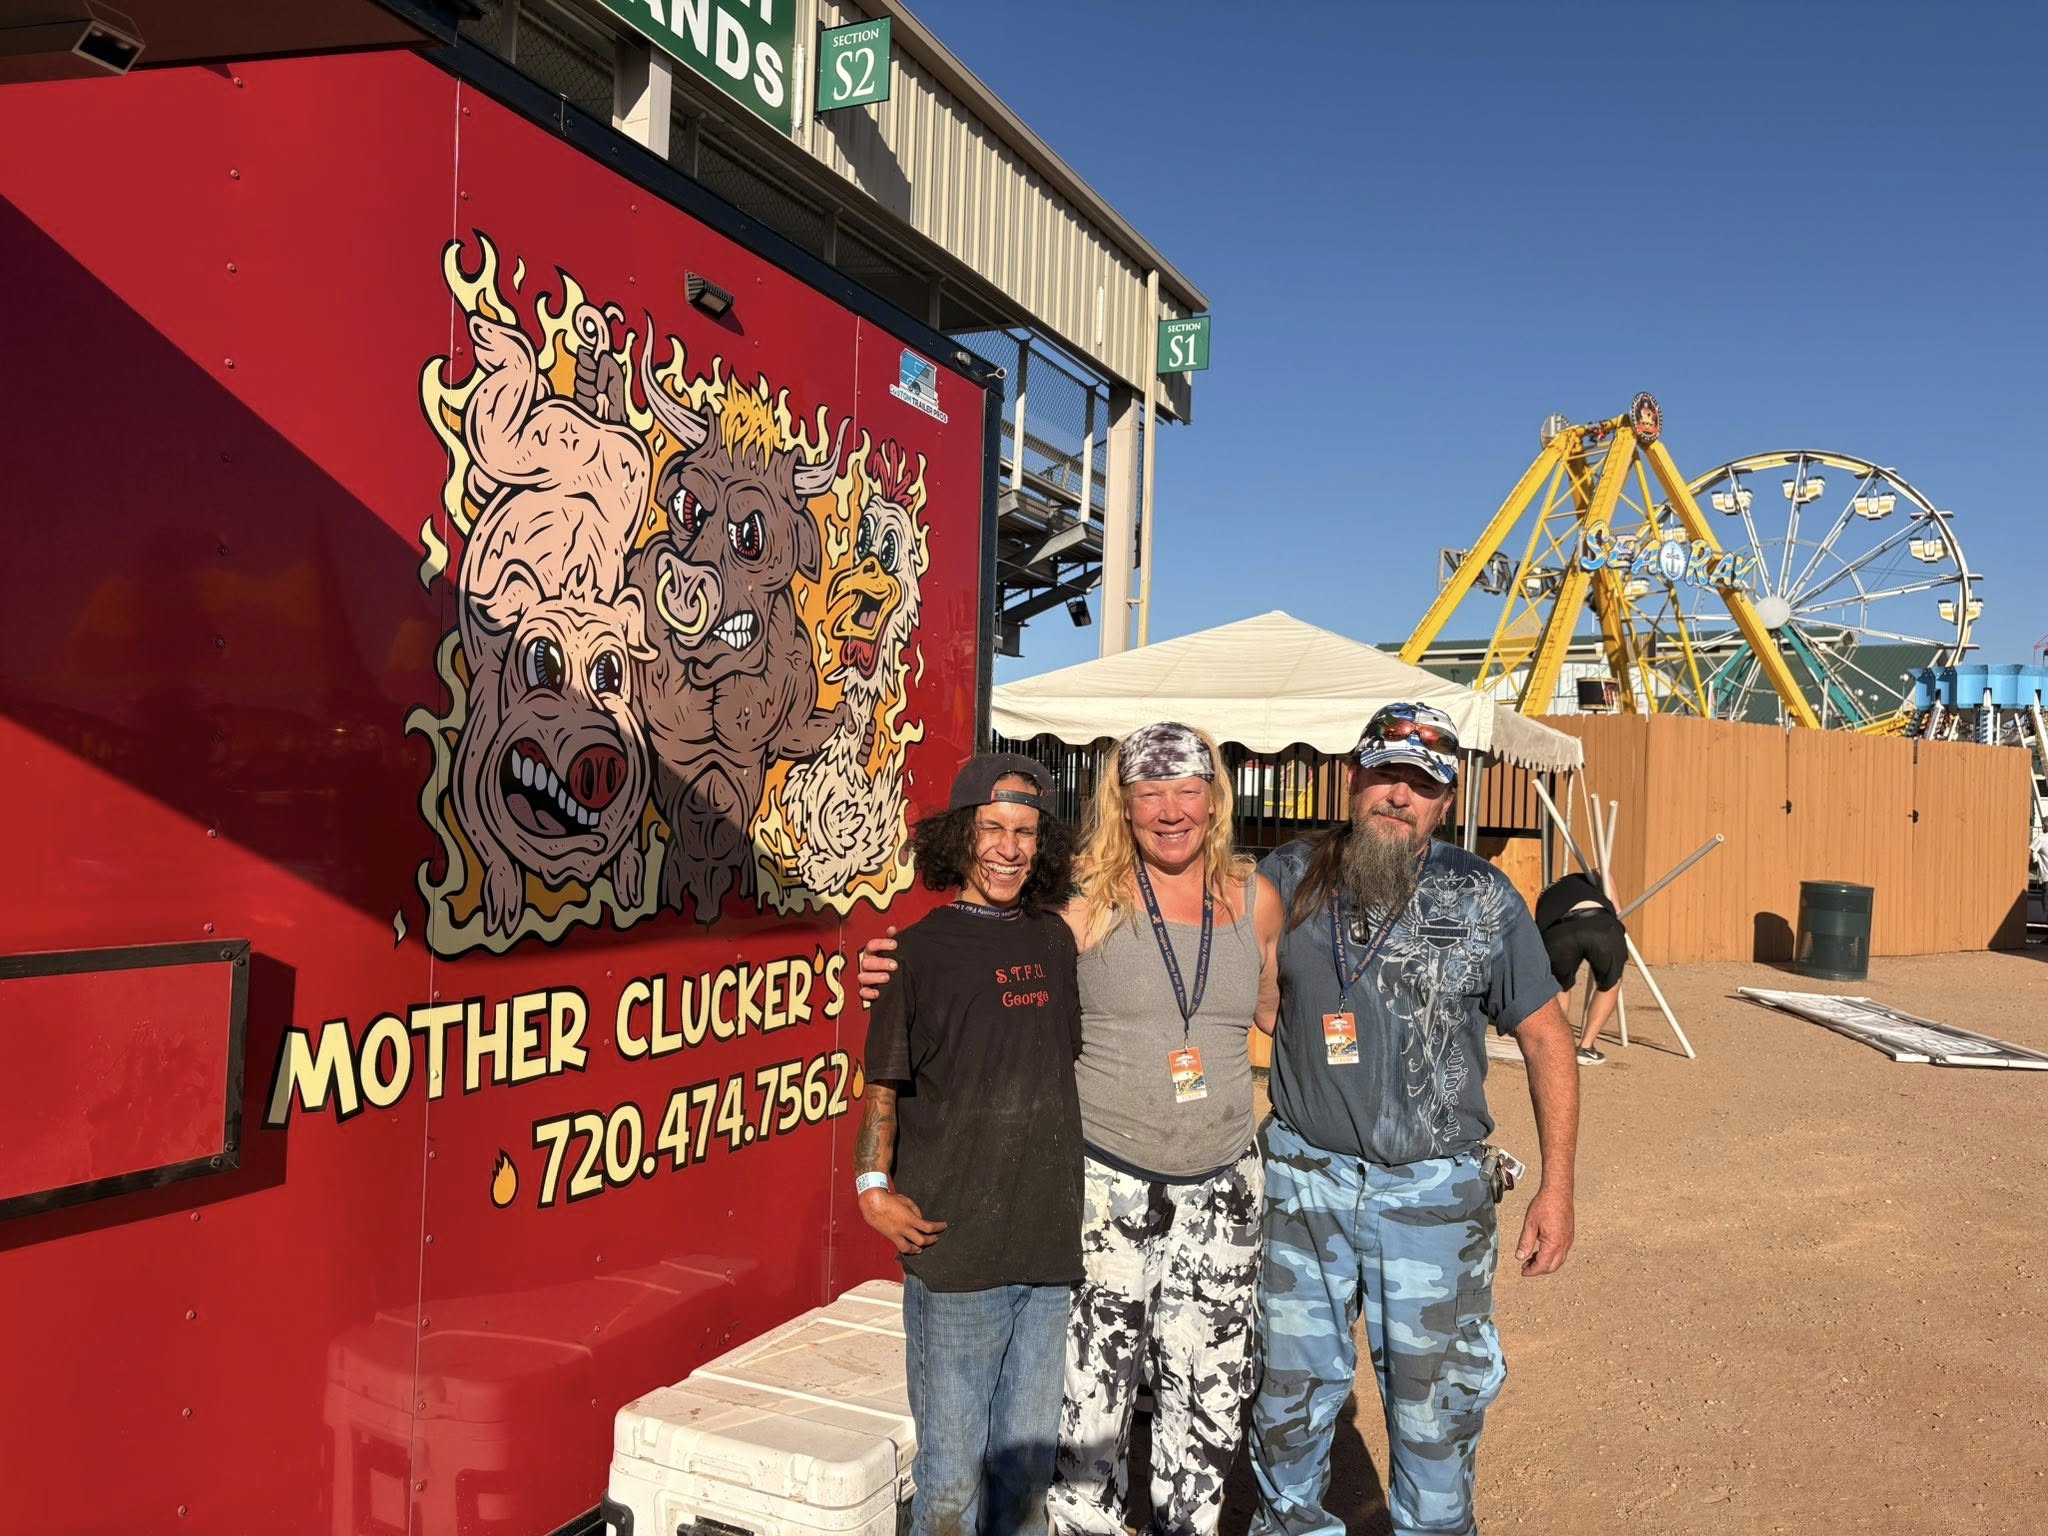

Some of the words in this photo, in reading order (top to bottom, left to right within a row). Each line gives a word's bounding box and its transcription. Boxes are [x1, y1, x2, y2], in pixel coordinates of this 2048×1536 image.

[833, 28, 879, 48] SECTION
[833, 47, 876, 101] S2
[1167, 322, 1201, 333] SECTION
[1168, 333, 1197, 368] S1
[912, 397, 933, 415] TRAILER
[933, 408, 947, 422] PROS
[1579, 520, 1661, 577] SEA
[1685, 538, 1758, 587] RAY
[995, 963, 1046, 984] S.T.F.U.
[1165, 951, 1176, 973] County
[1002, 990, 1049, 1008] George
[263, 987, 588, 1128] MOTHER
[614, 948, 847, 1058] CLUCKER'S
[534, 1053, 849, 1206] 720.474.7562
